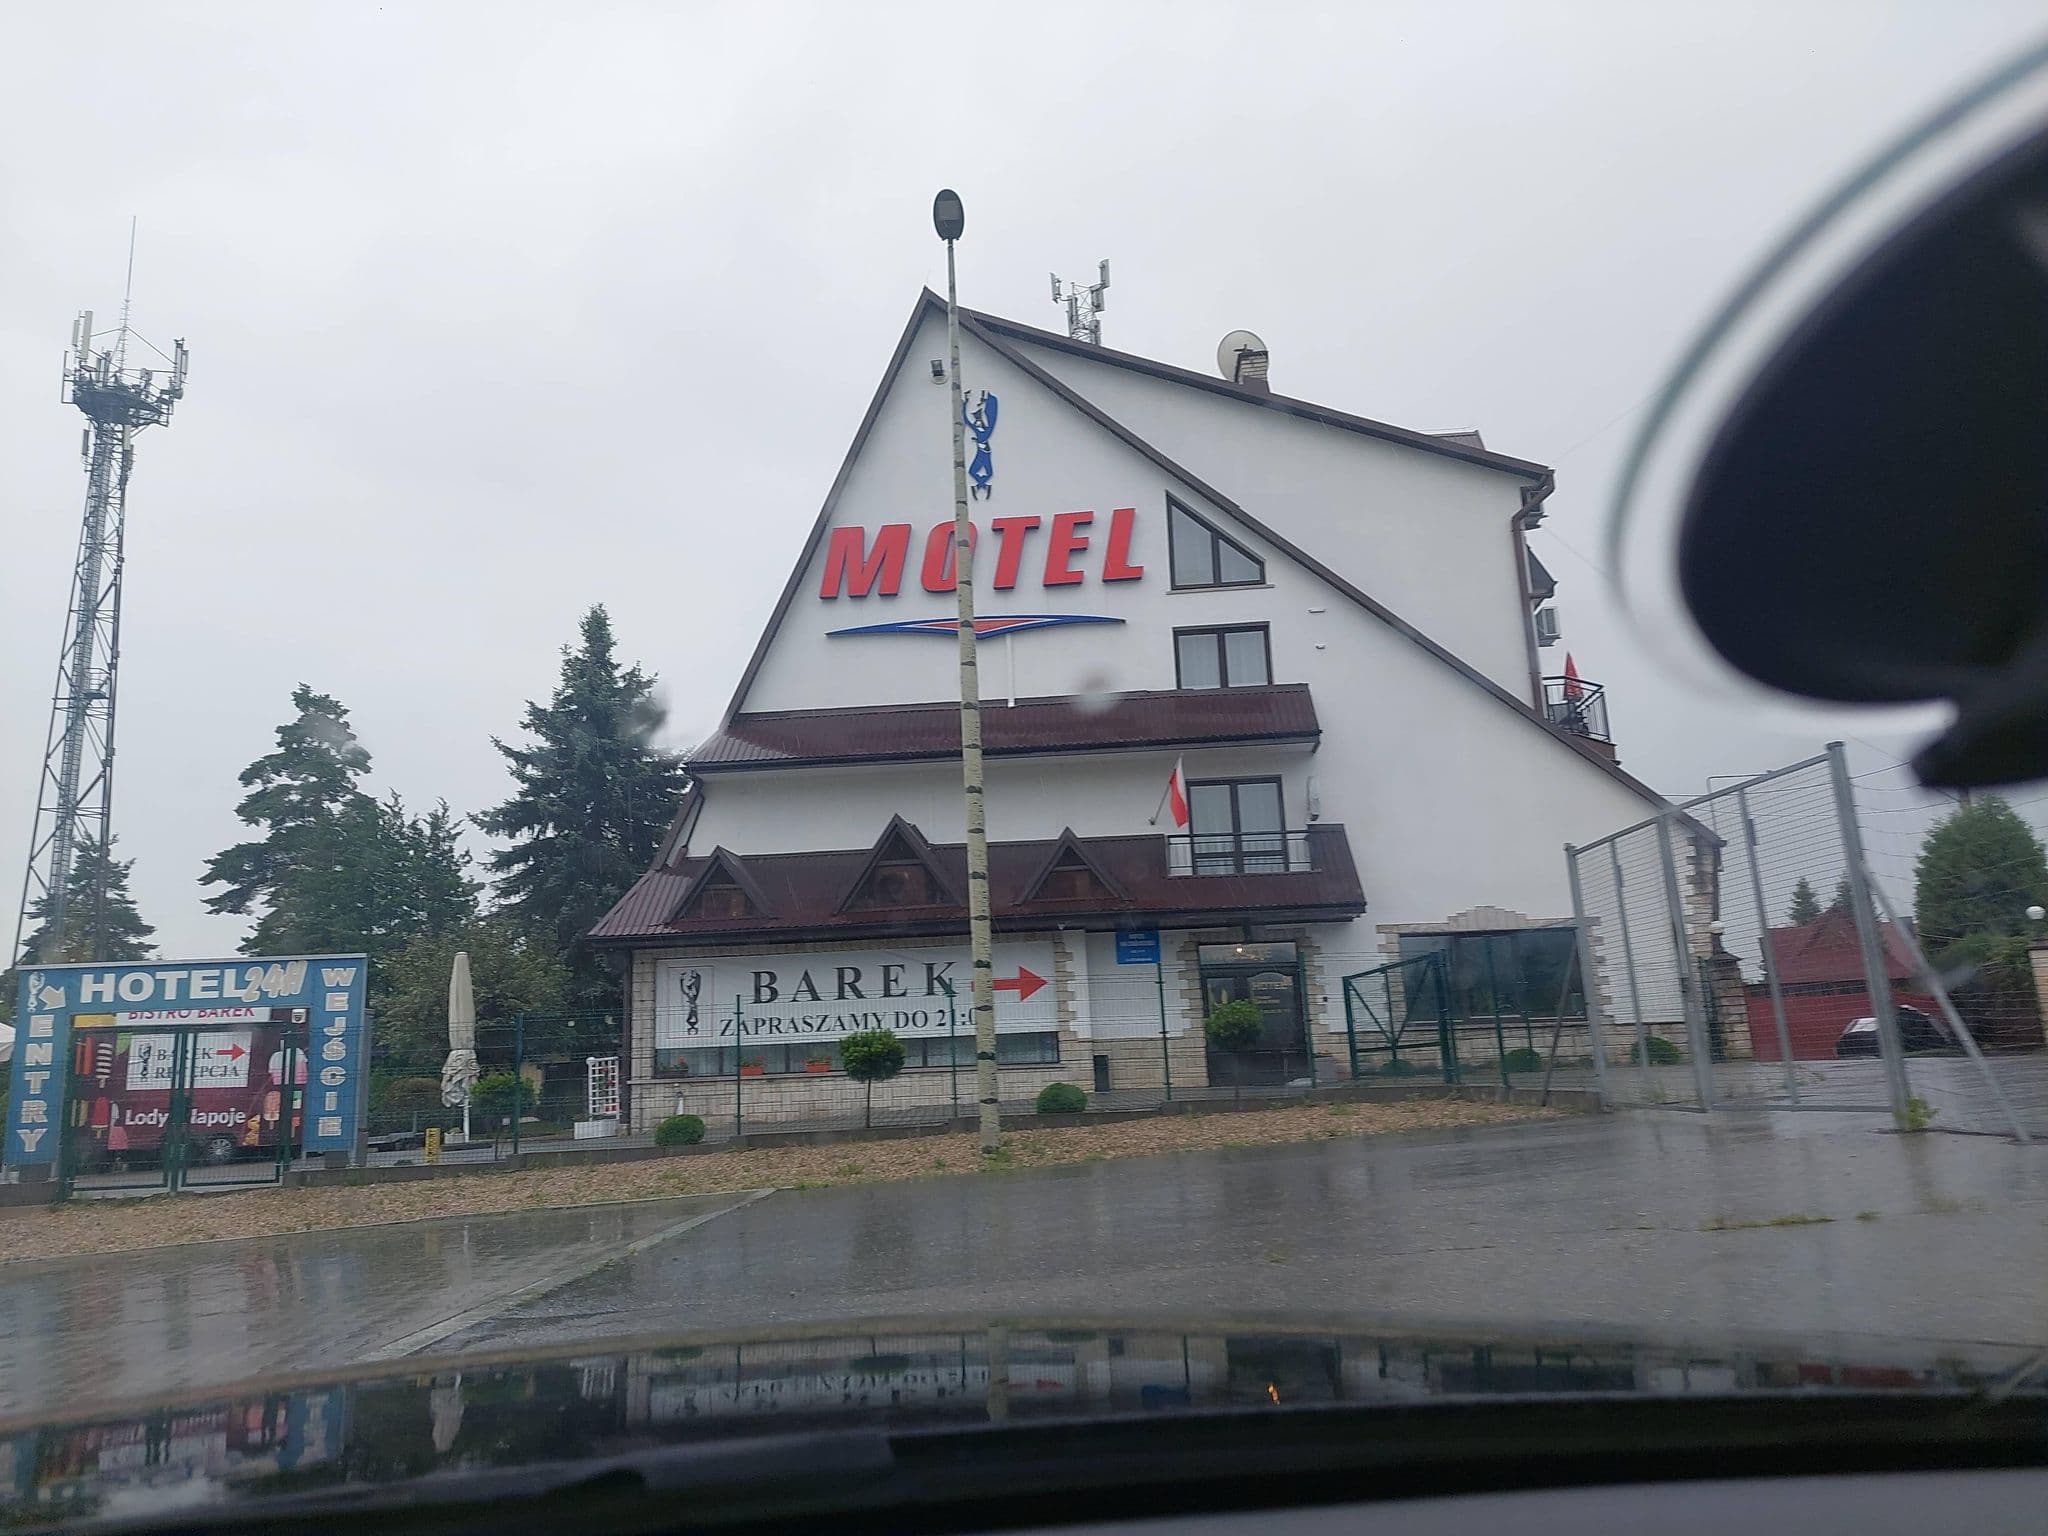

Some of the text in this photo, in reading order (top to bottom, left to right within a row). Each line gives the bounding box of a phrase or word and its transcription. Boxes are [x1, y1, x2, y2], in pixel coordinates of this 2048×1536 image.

[818, 507, 1145, 600] MOTEL
[80, 968, 246, 1003] HOTEL
[749, 960, 957, 1005] BAREK
[127, 1006, 255, 1020] BISTRO BAREK
[720, 1011, 890, 1037] ZAPRASZAMY
[892, 1008, 929, 1030] DO
[317, 967, 357, 1137] WEJŚCIE
[16, 1014, 55, 1153] ENTRY
[125, 1108, 170, 1127] Lody
